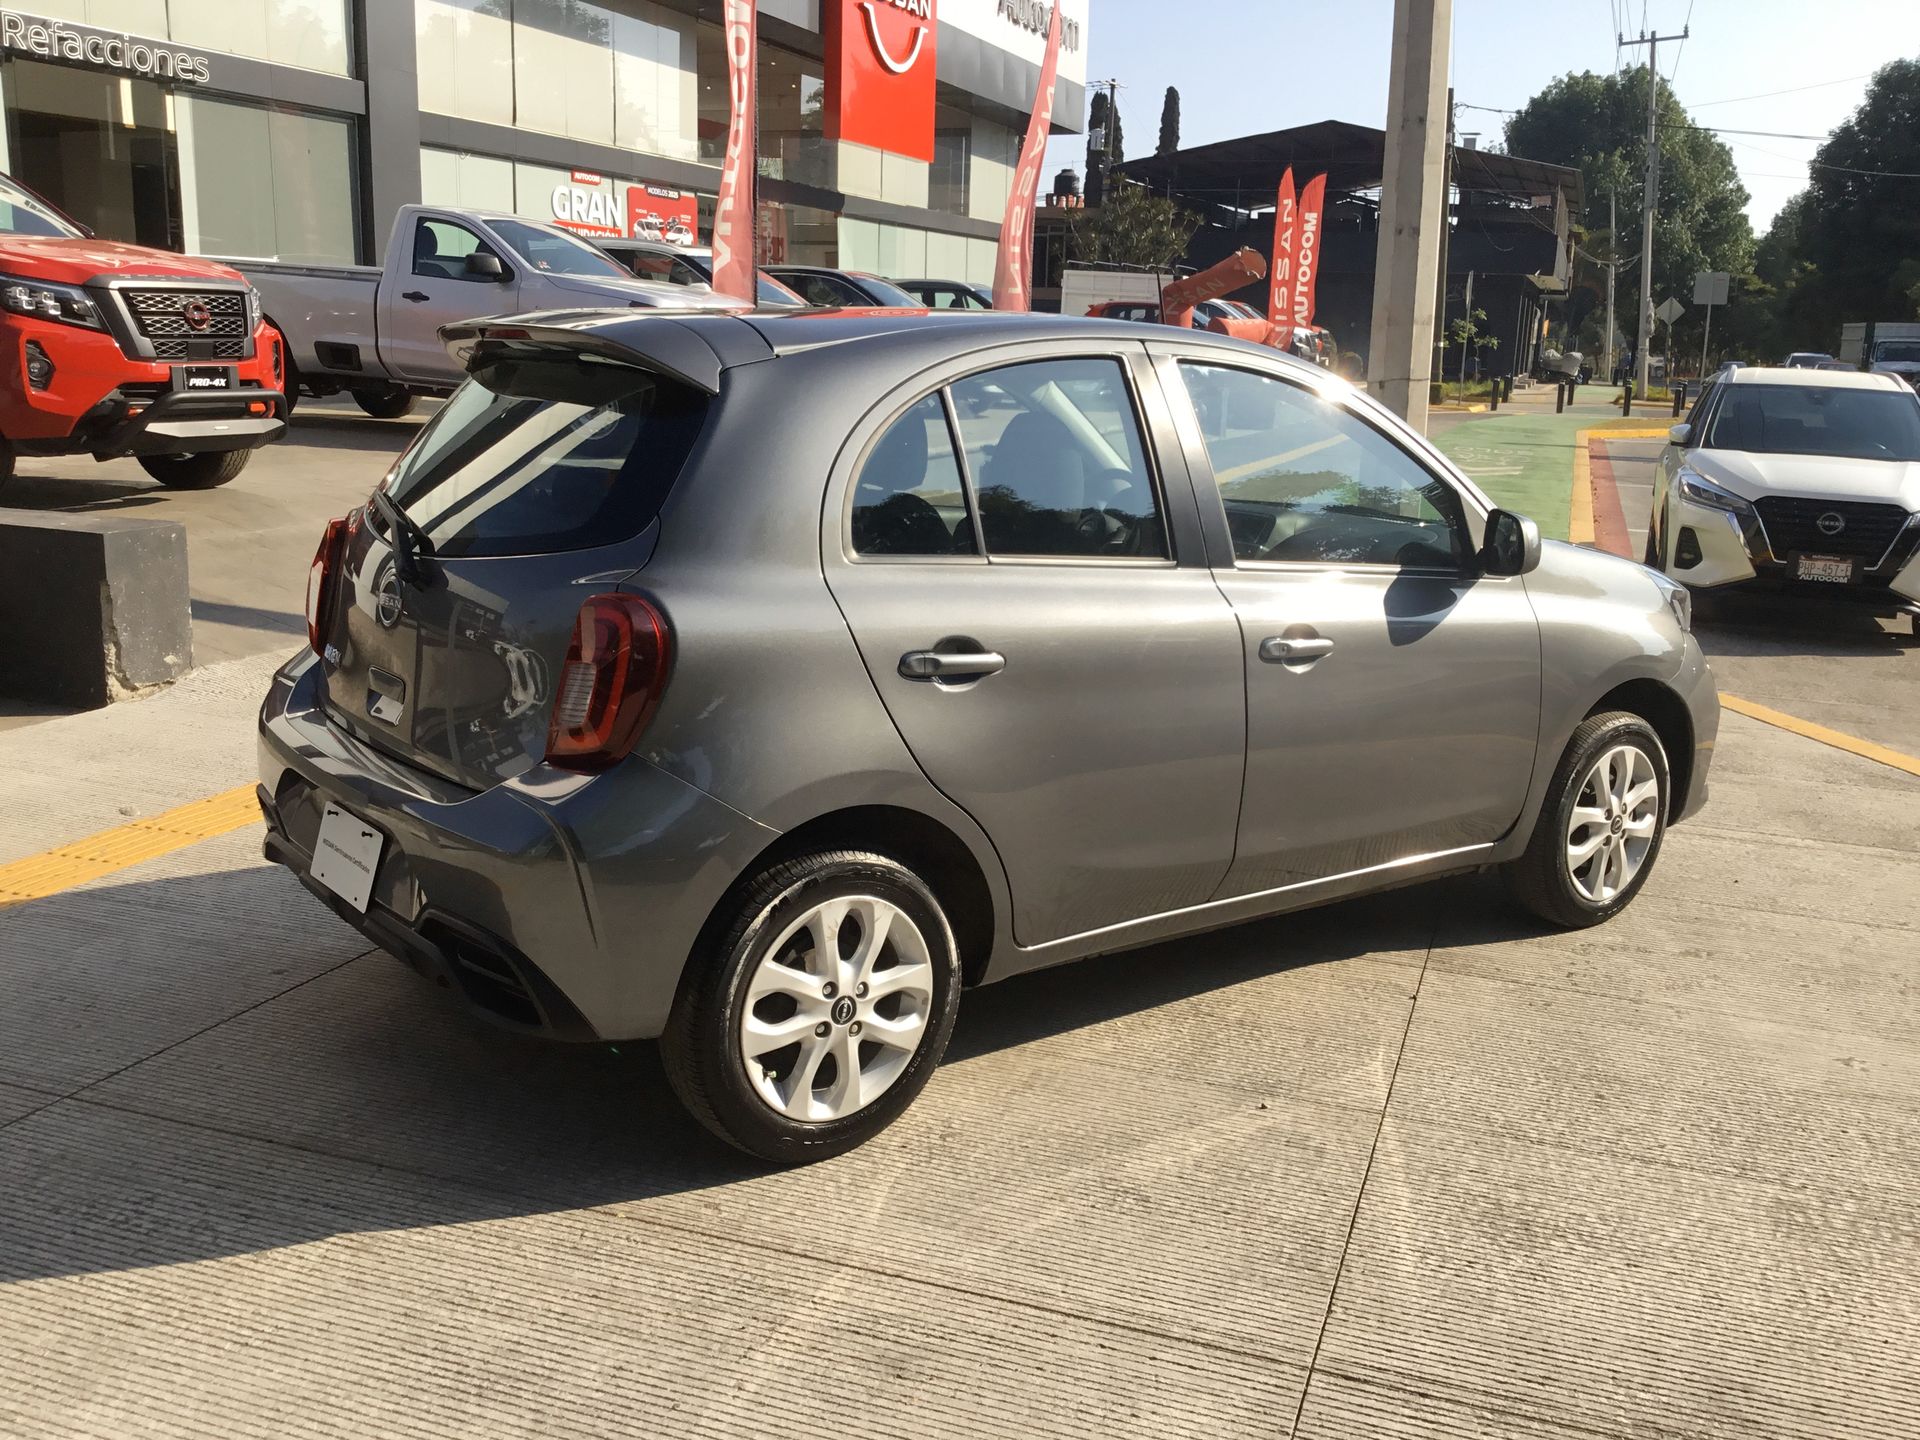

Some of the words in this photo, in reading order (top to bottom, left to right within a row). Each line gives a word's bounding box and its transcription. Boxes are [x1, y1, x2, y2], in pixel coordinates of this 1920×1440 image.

[1, 11, 210, 83] Refacciones
[574, 172, 600, 182] AUTOCOM
[551, 185, 622, 227] GRAN
[1274, 198, 1293, 348] NISSAN
[1294, 212, 1318, 326] AUTOCOM
[189, 378, 227, 387] PRO-4X
[1799, 573, 1848, 583] AUTOCOM
